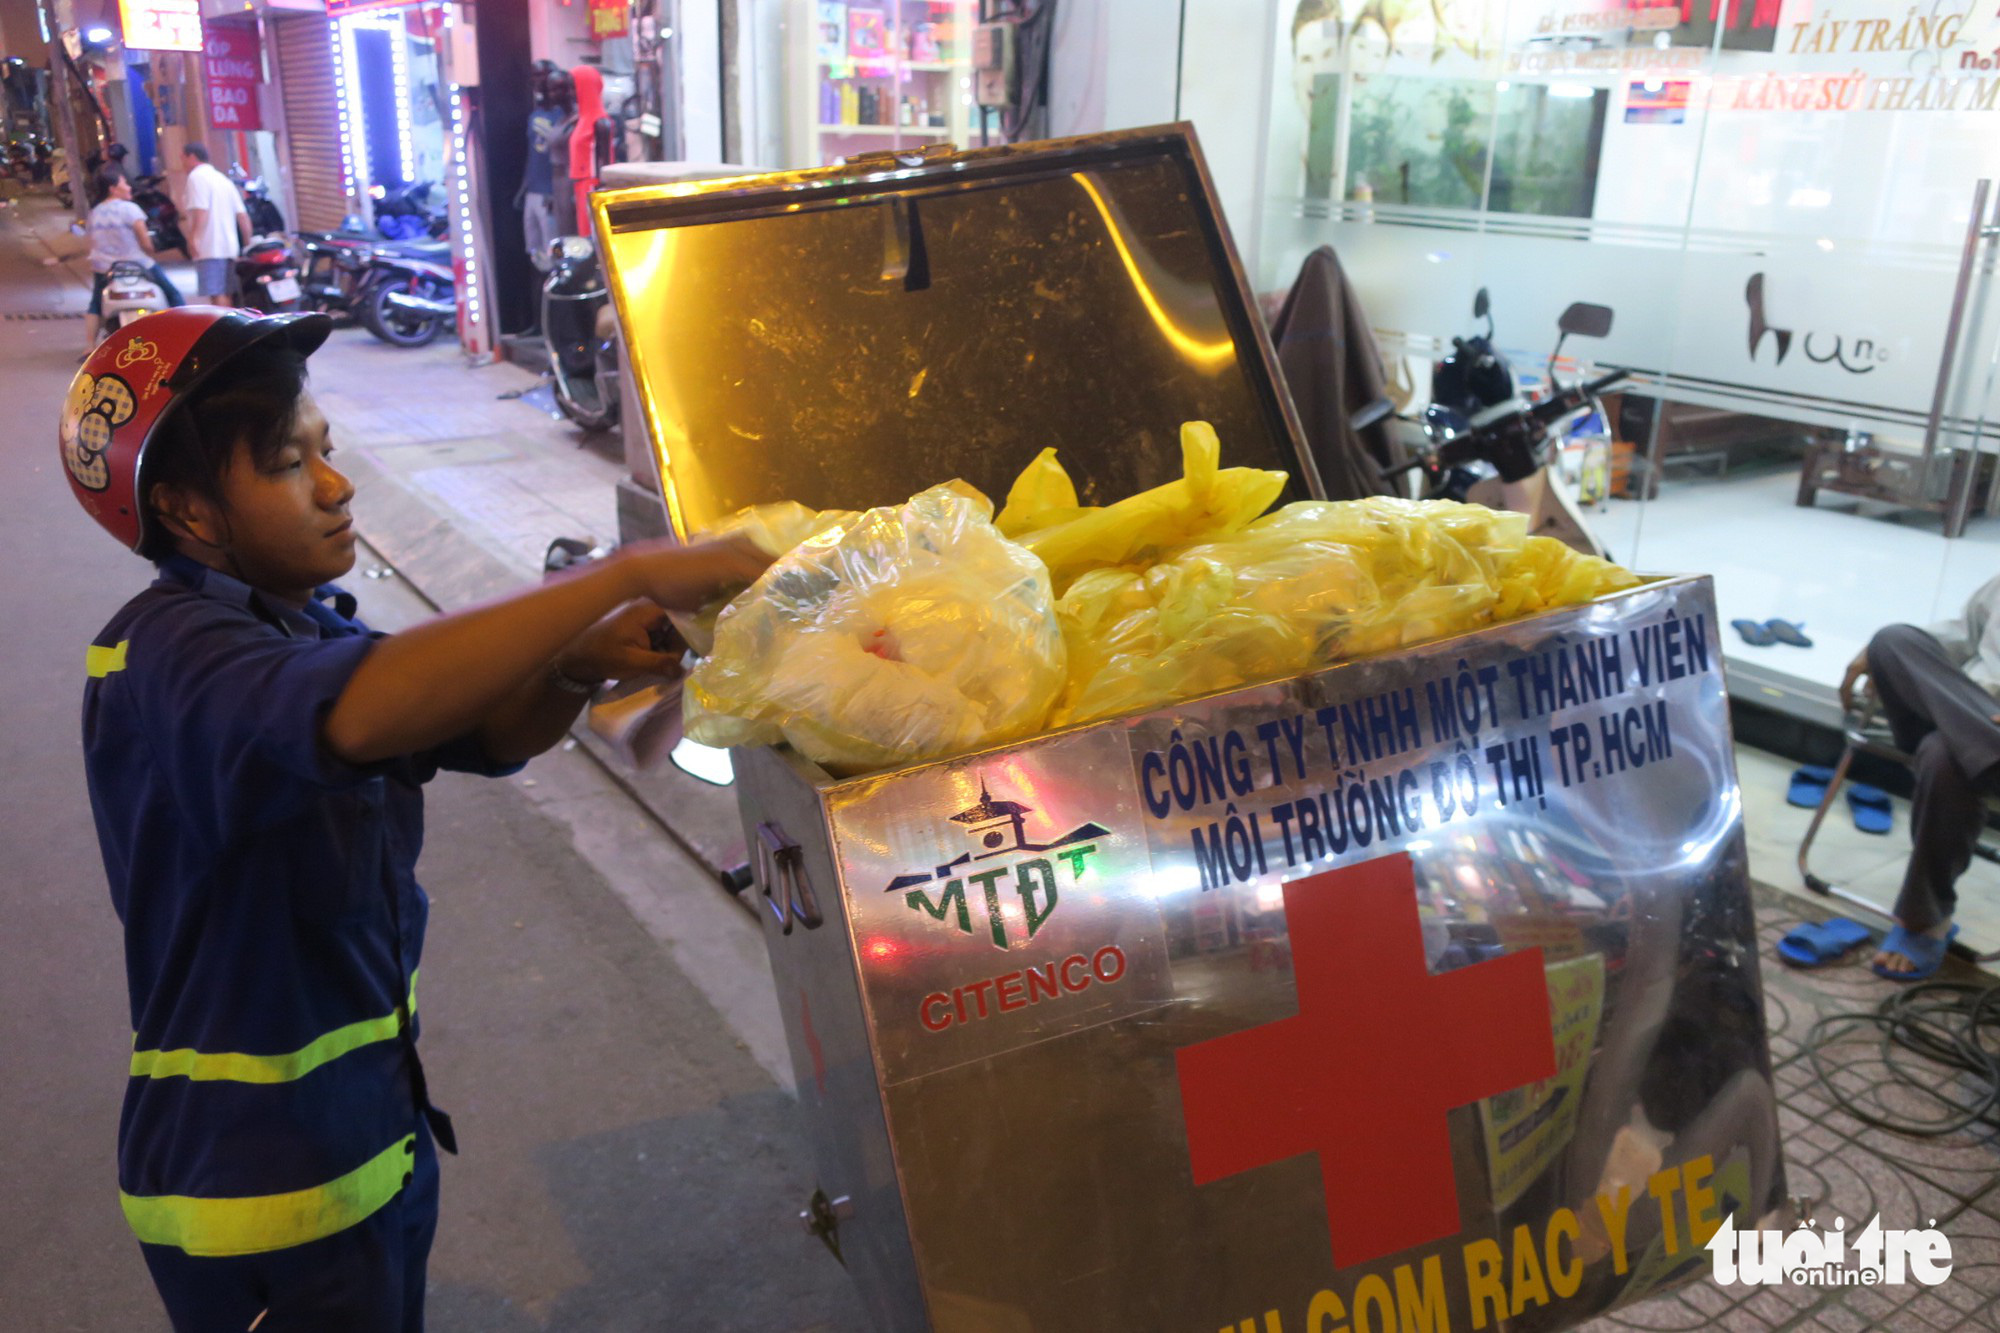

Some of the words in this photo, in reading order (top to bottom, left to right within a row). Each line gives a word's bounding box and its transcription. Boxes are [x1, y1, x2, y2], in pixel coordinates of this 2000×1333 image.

[213, 105, 239, 123] DA
[1142, 728, 1254, 819] CÔNG
[1256, 715, 1306, 786] TY
[1316, 688, 1422, 771] TNHH
[1425, 658, 1499, 749] MỘT
[1507, 637, 1625, 720] THÀNH
[1630, 608, 1708, 687] VIÊN
[1190, 803, 1268, 892] MÔI
[1271, 768, 1425, 868] TRƯỜNG
[1486, 735, 1547, 810] THỊ
[1550, 700, 1673, 788] TP.HCM
[920, 945, 1127, 1032] CITENCO
[1596, 1184, 1631, 1276] Y
